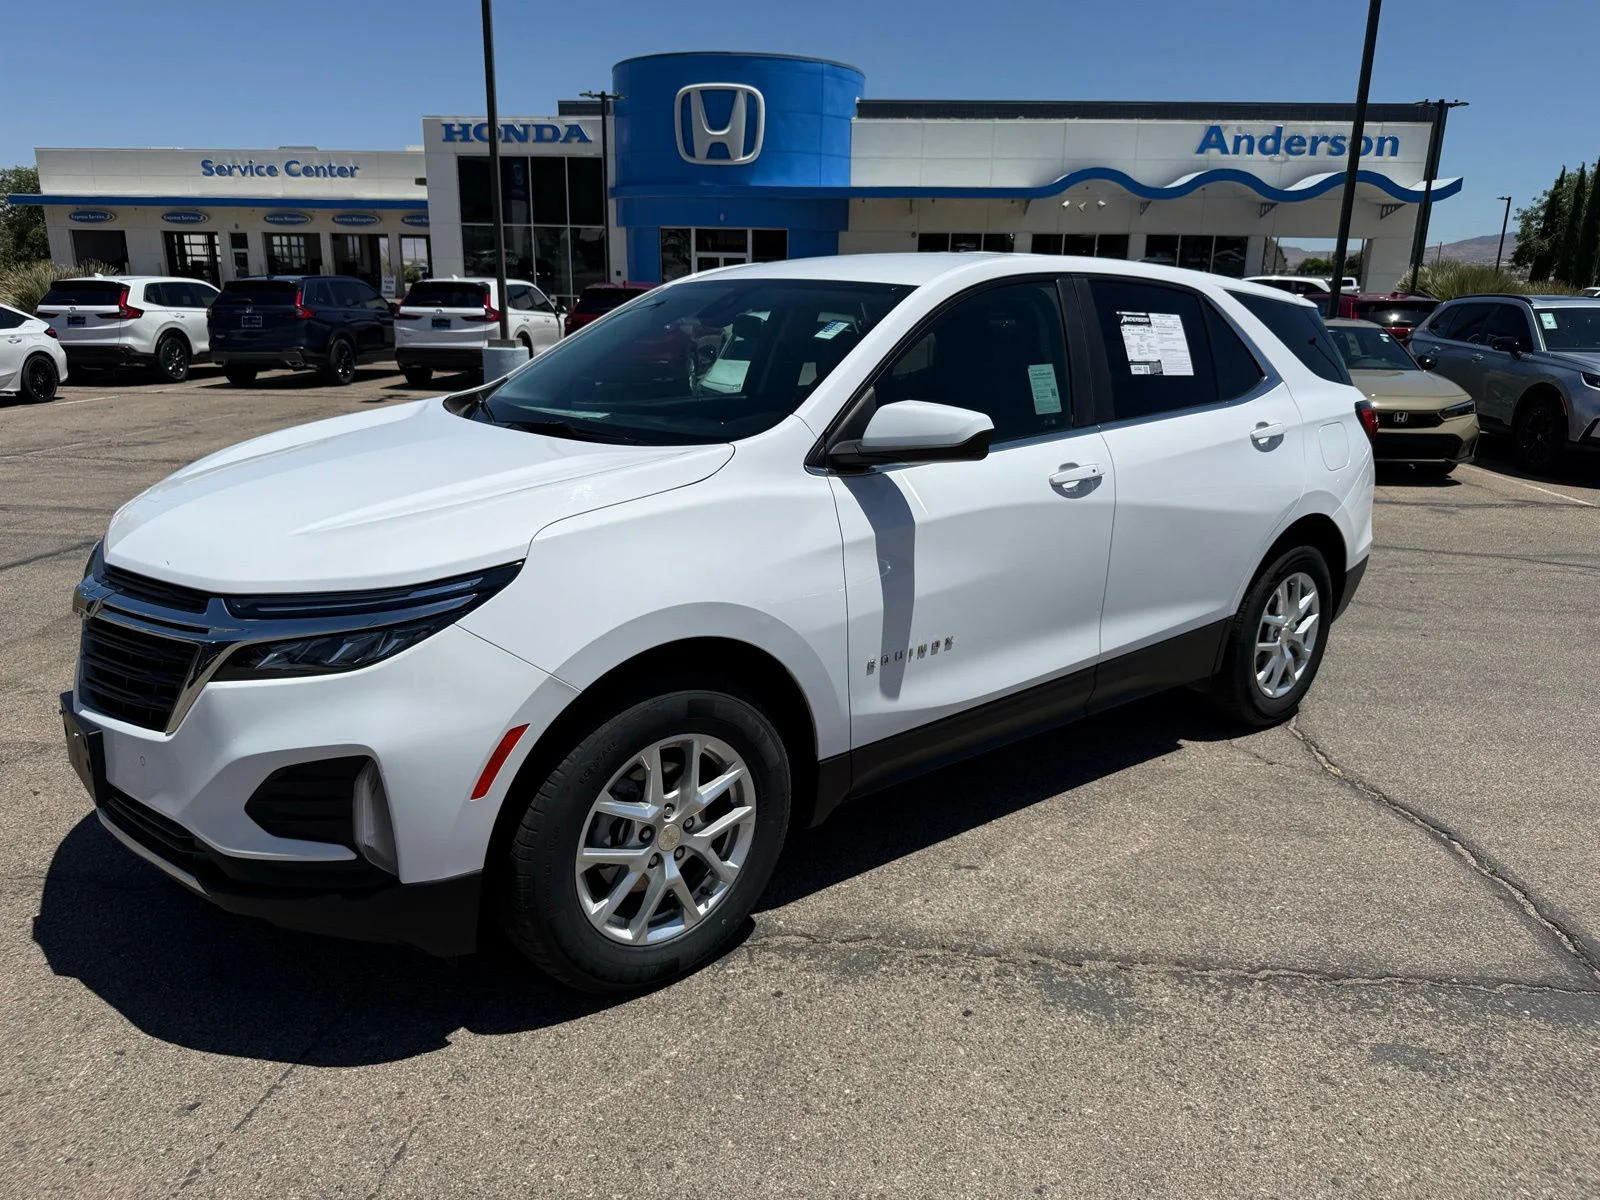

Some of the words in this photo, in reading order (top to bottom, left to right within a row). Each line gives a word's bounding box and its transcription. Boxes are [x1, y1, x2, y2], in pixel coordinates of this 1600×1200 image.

[441, 122, 593, 144] HONDA
[1196, 125, 1400, 157] Anderson
[201, 159, 279, 177] Service
[284, 160, 360, 178] Center
[866, 636, 954, 676] EQUINOX
